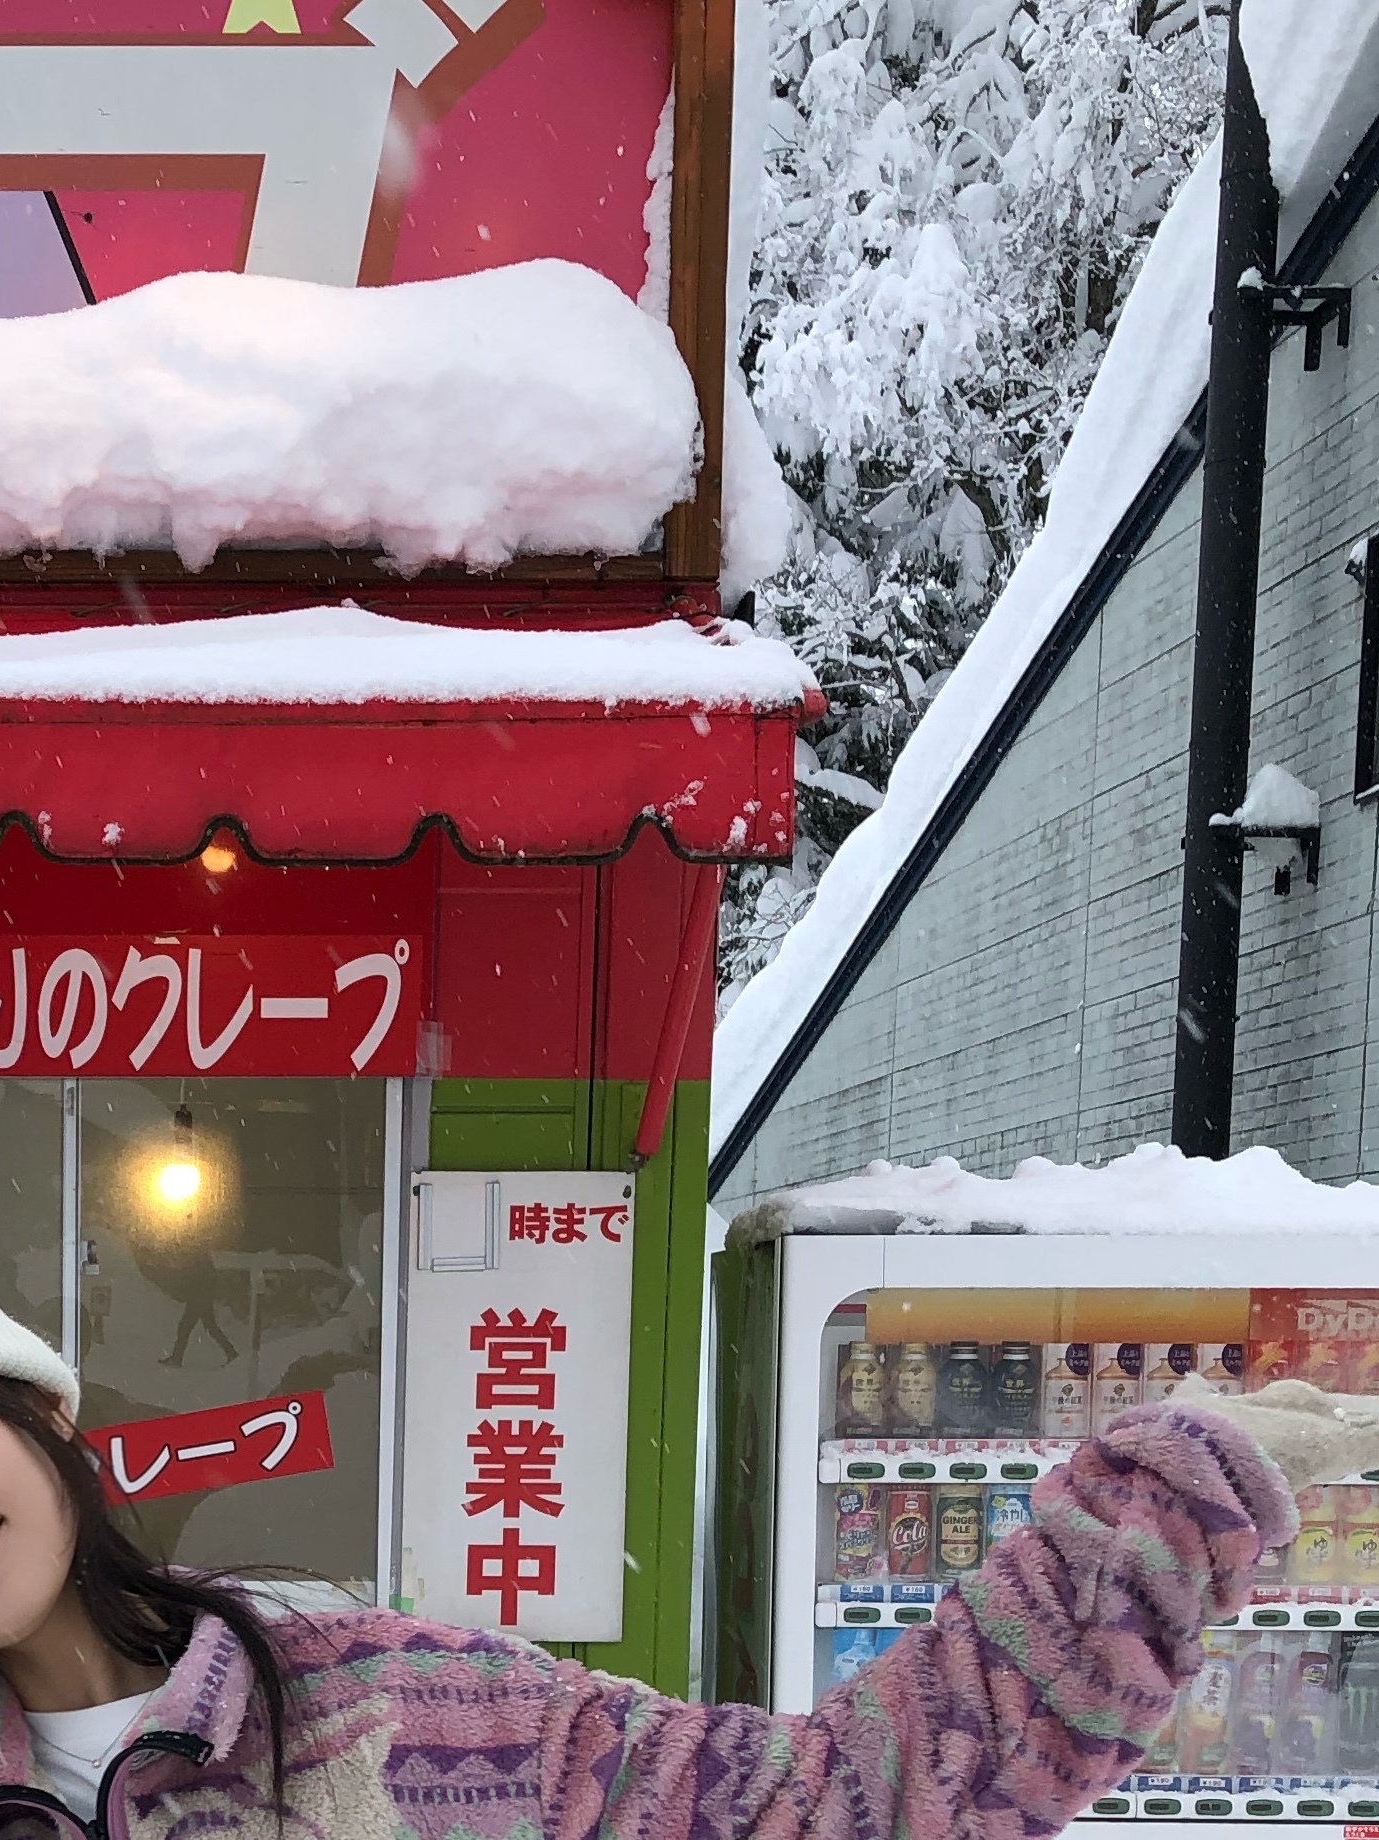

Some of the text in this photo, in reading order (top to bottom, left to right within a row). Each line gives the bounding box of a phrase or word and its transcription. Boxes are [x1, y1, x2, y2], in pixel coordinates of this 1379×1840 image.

[509, 1203, 630, 1245] 時まで
[1297, 1303, 1379, 1336] DyD
[461, 1307, 567, 1627] 営業中
[892, 1521, 927, 1545] Cola
